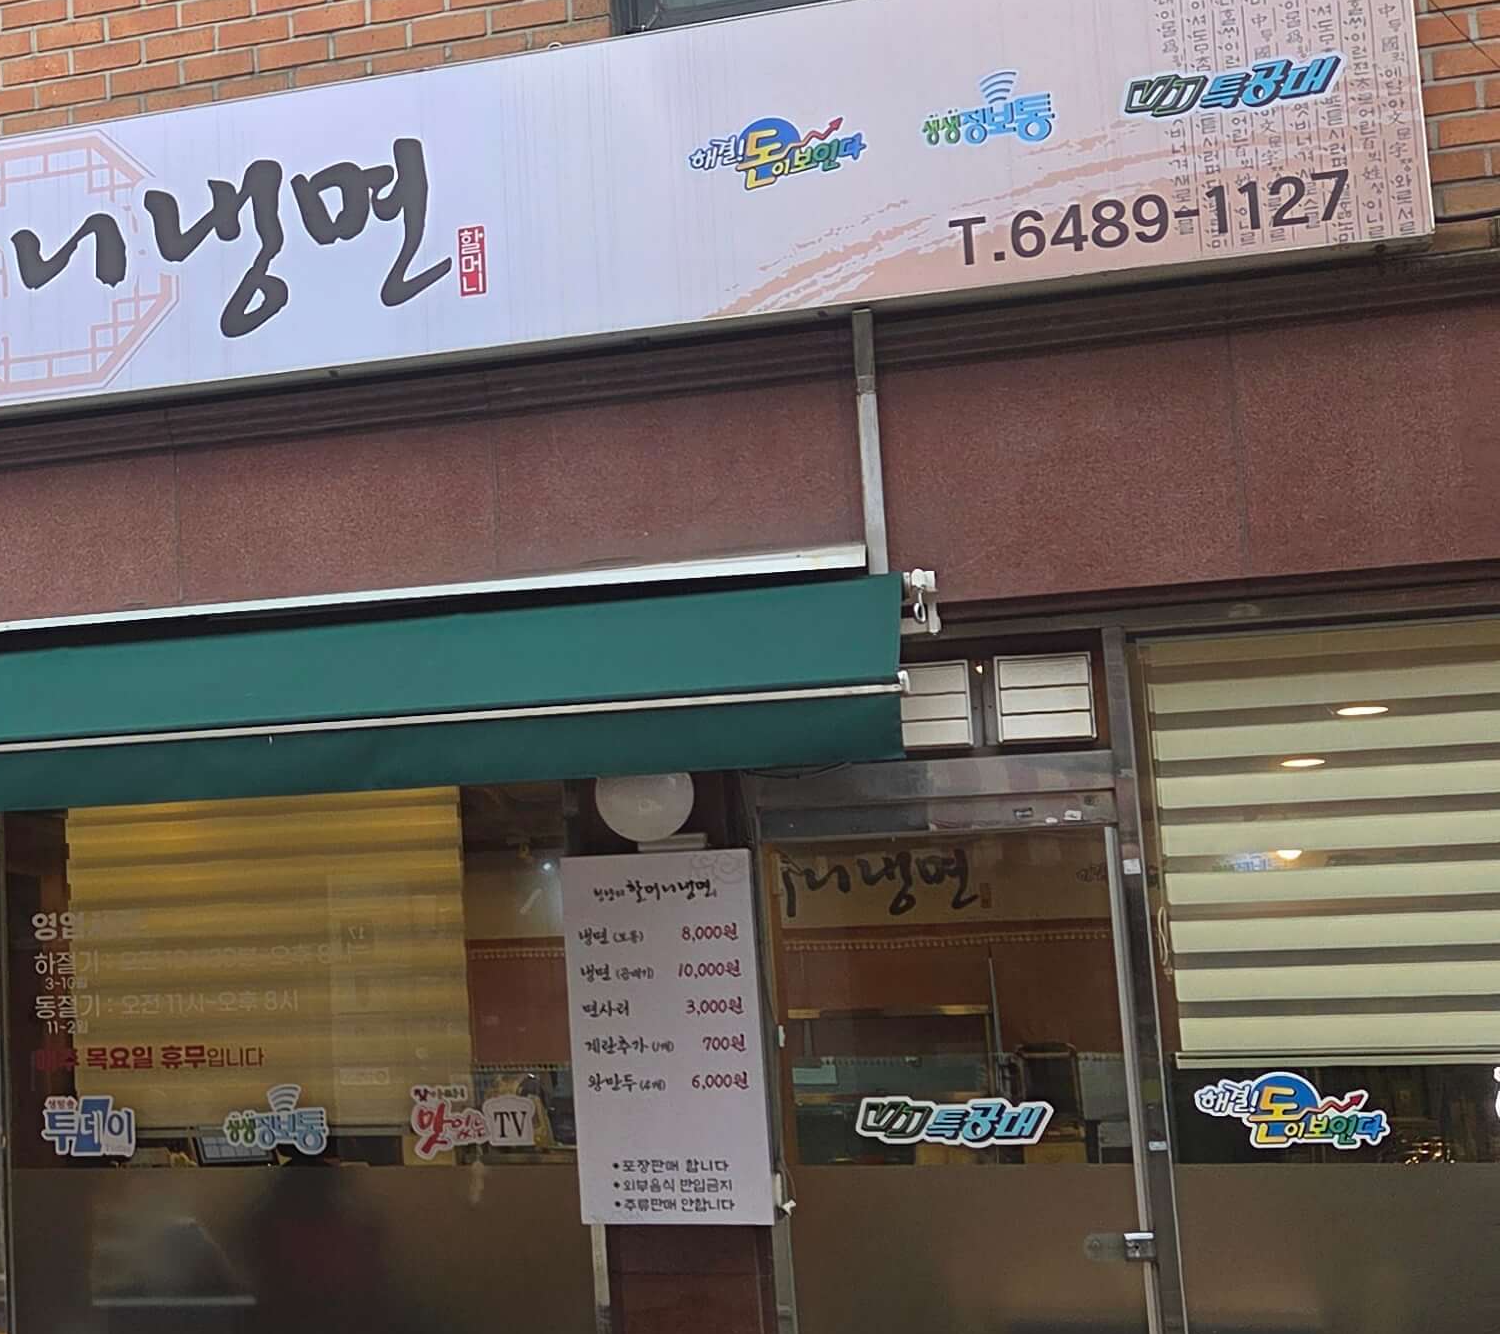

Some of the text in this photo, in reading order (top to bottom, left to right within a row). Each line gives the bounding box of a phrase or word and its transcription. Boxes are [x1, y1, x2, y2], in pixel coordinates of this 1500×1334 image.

[950, 171, 1349, 265] T.6489-1127
[459, 227, 485, 298] 할머니
[578, 927, 610, 946] 냉면
[681, 922, 739, 942] 8,000원
[33, 950, 100, 975] 하절기
[581, 963, 611, 982] 냉면
[678, 959, 742, 979] 10,000원
[34, 995, 100, 1019] 동절기
[582, 996, 744, 1018] 면사리 3,000원
[585, 1036, 649, 1055] 계란추가
[702, 1034, 747, 1053] 700원
[87, 1046, 153, 1070] 목요일
[161, 1045, 265, 1070] 휴무입니다
[588, 1073, 638, 1092] 왕만두
[691, 1071, 750, 1090] 6,000원
[45, 1109, 133, 1152] 투데이
[494, 1111, 527, 1138] TV
[623, 1158, 729, 1173] 포장판매 합니다
[623, 1178, 733, 1193] 외부음식 반입금지
[624, 1197, 735, 1212] 주류판매 안합니다
